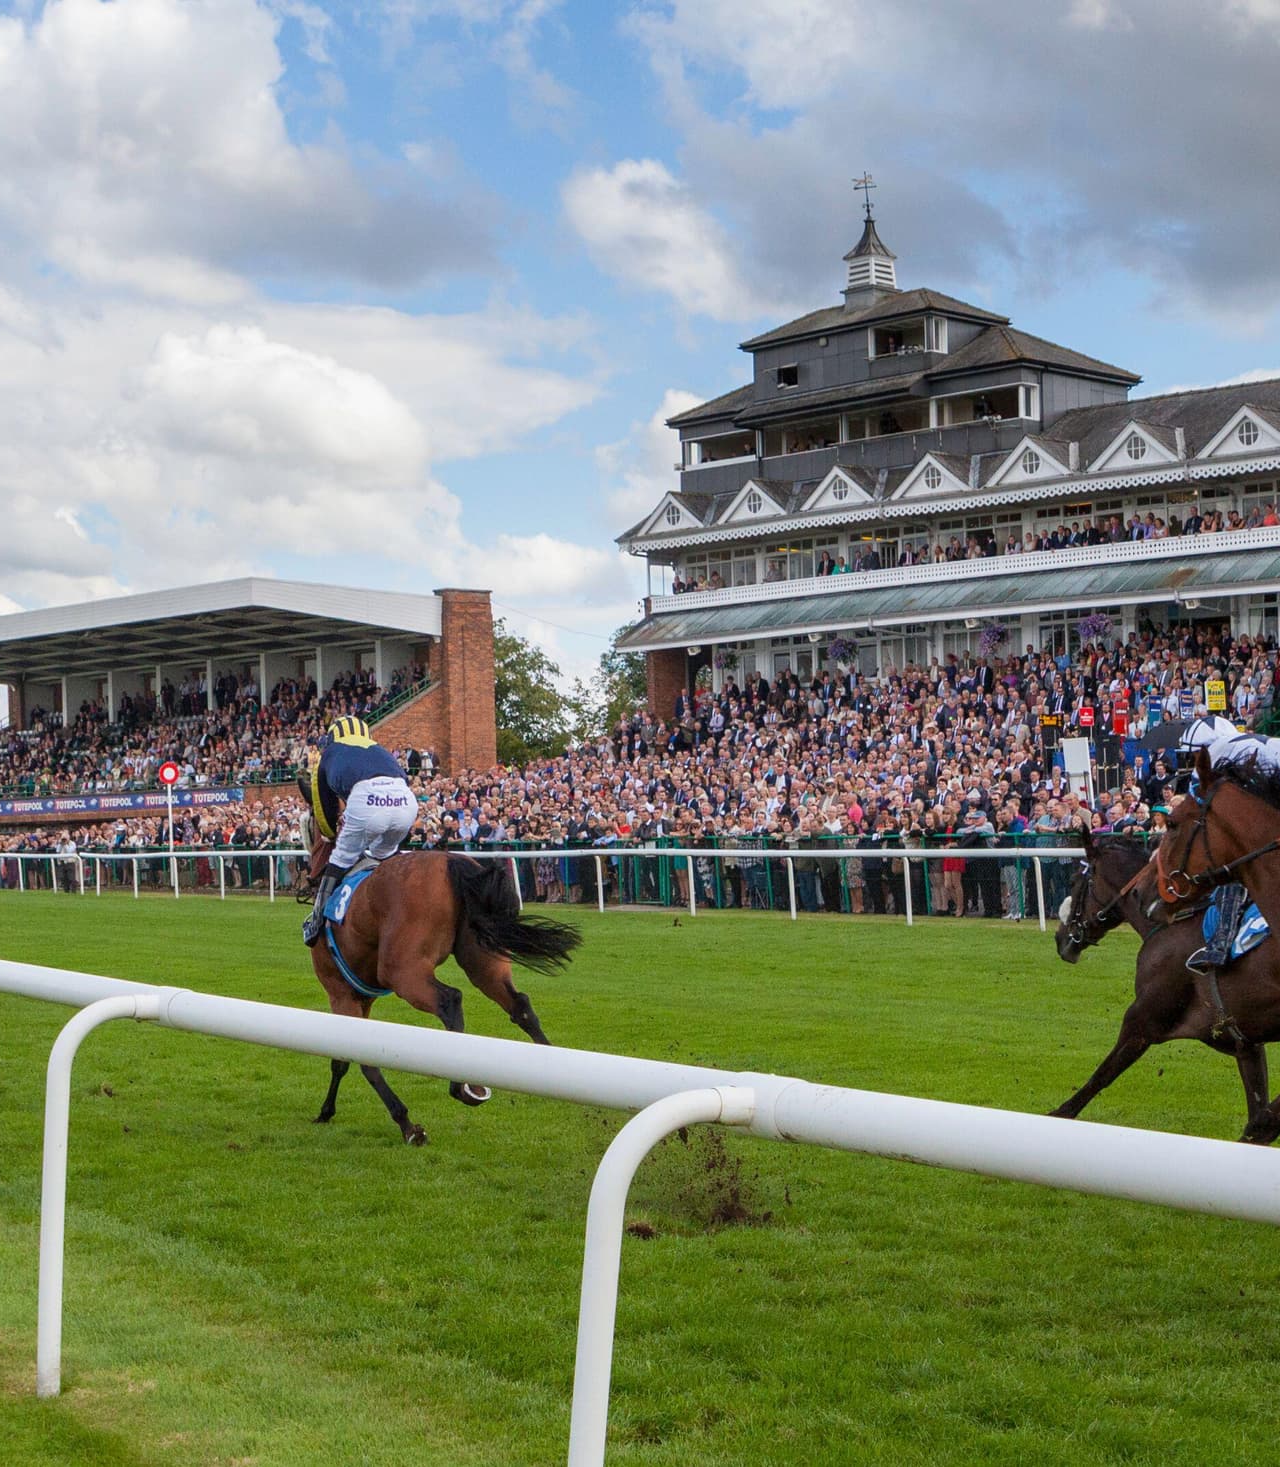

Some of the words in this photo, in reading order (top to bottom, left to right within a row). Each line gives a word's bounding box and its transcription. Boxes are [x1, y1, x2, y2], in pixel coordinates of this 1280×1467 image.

[14, 802, 43, 812] TOTEPOOL
[101, 797, 133, 807] TOTEPOOL
[194, 792, 229, 803] TOTEPOOL
[366, 794, 408, 807] Stobart
[335, 884, 352, 920] 3
